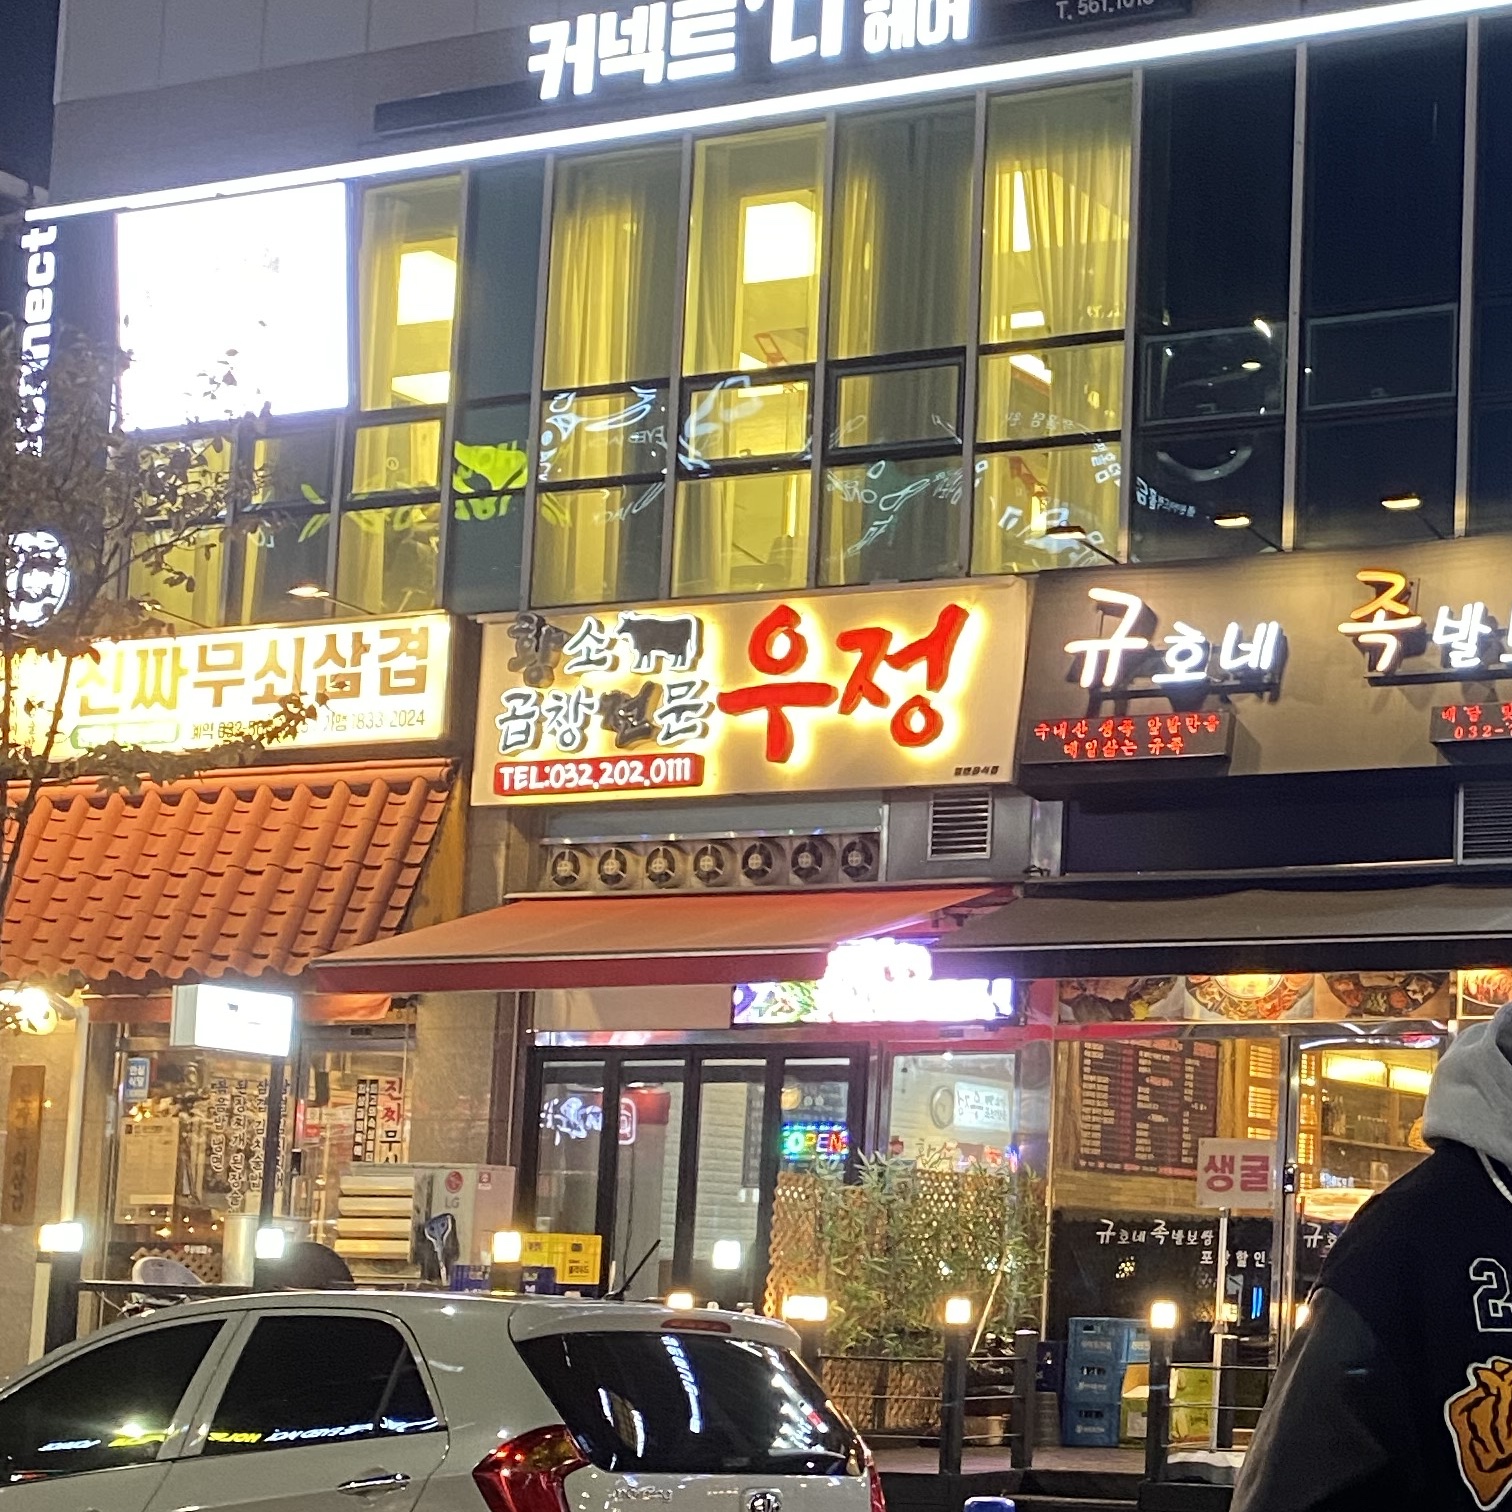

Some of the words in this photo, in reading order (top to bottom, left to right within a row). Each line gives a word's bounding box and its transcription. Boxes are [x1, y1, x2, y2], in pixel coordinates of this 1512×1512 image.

[1063, 587, 1282, 689] 규호네
[717, 604, 970, 763] 우정
[1441, 705, 1483, 724] 배달
[787, 1132, 845, 1154] OPEN
[1204, 1154, 1270, 1193] 생굴
[445, 1197, 460, 1209] LG
[1095, 1218, 1147, 1245] 규호네
